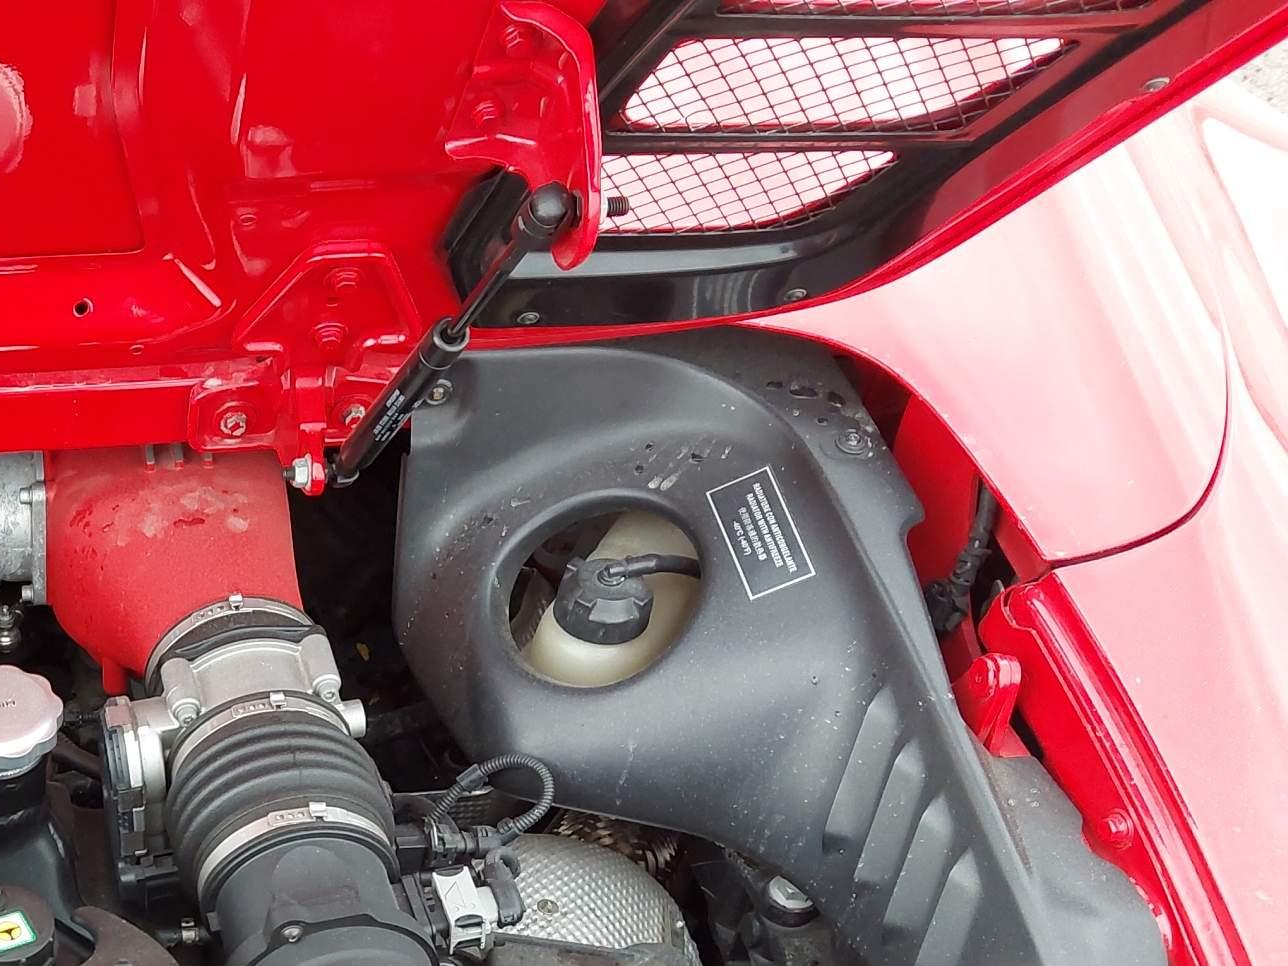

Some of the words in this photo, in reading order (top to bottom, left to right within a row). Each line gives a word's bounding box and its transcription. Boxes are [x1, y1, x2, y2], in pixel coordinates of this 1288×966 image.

[746, 493, 763, 520] RADIATOR
[758, 519, 769, 534] WITH
[764, 533, 783, 567] ANTIFREEZE
[753, 482, 771, 513] RADIATORE
[766, 512, 776, 525] CON
